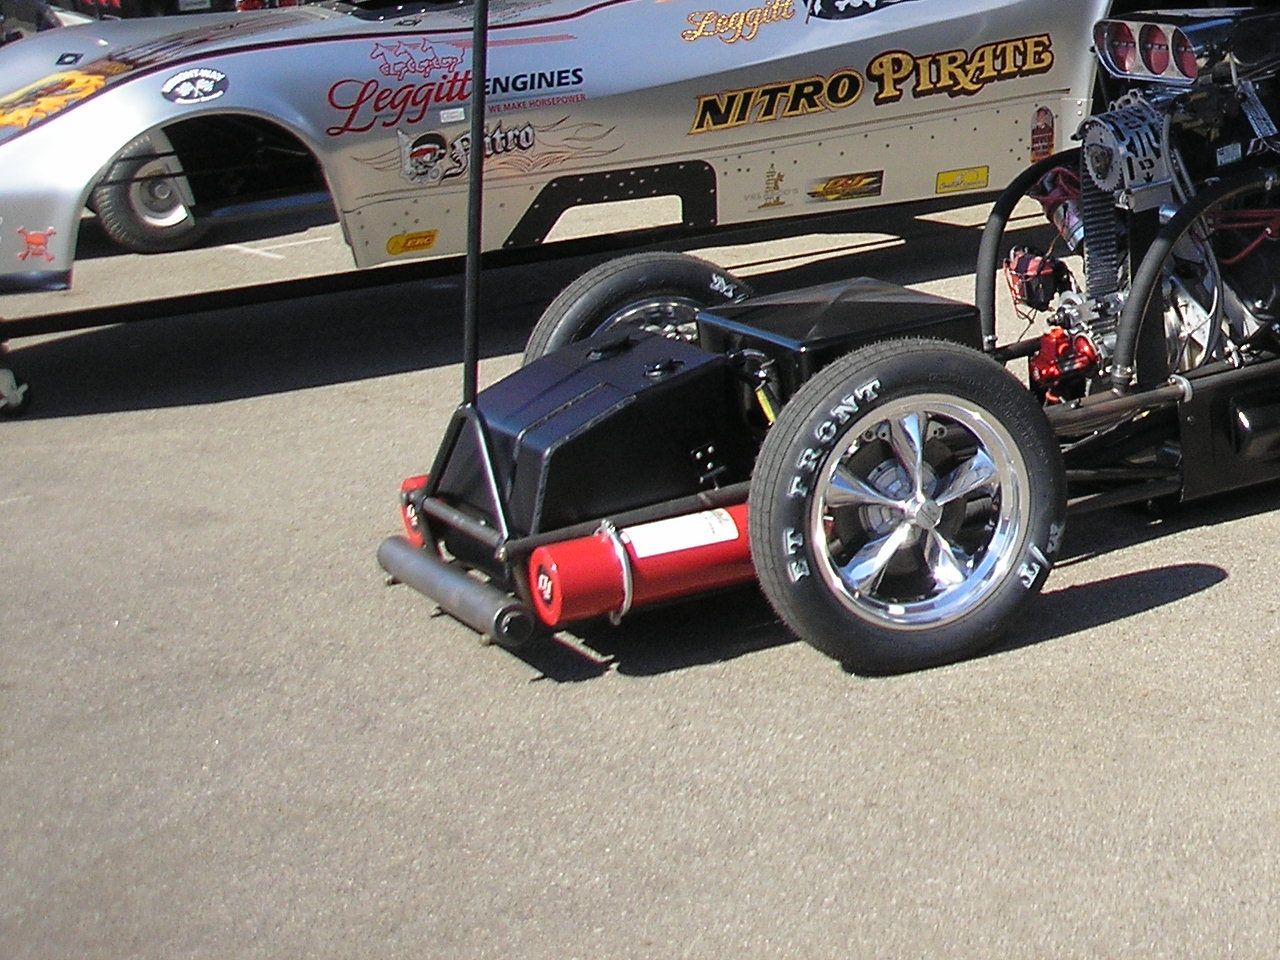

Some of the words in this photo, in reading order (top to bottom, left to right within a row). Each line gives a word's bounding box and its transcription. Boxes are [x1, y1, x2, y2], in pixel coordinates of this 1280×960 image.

[325, 70, 473, 137] Leggitt
[488, 101, 500, 113] WE
[503, 100, 528, 112] MAKE
[529, 93, 587, 109] HORSEPOWER
[687, 68, 864, 136] NITRO
[867, 33, 1057, 106] PIRATE
[789, 378, 881, 498] FRONT
[783, 527, 810, 583] ET
